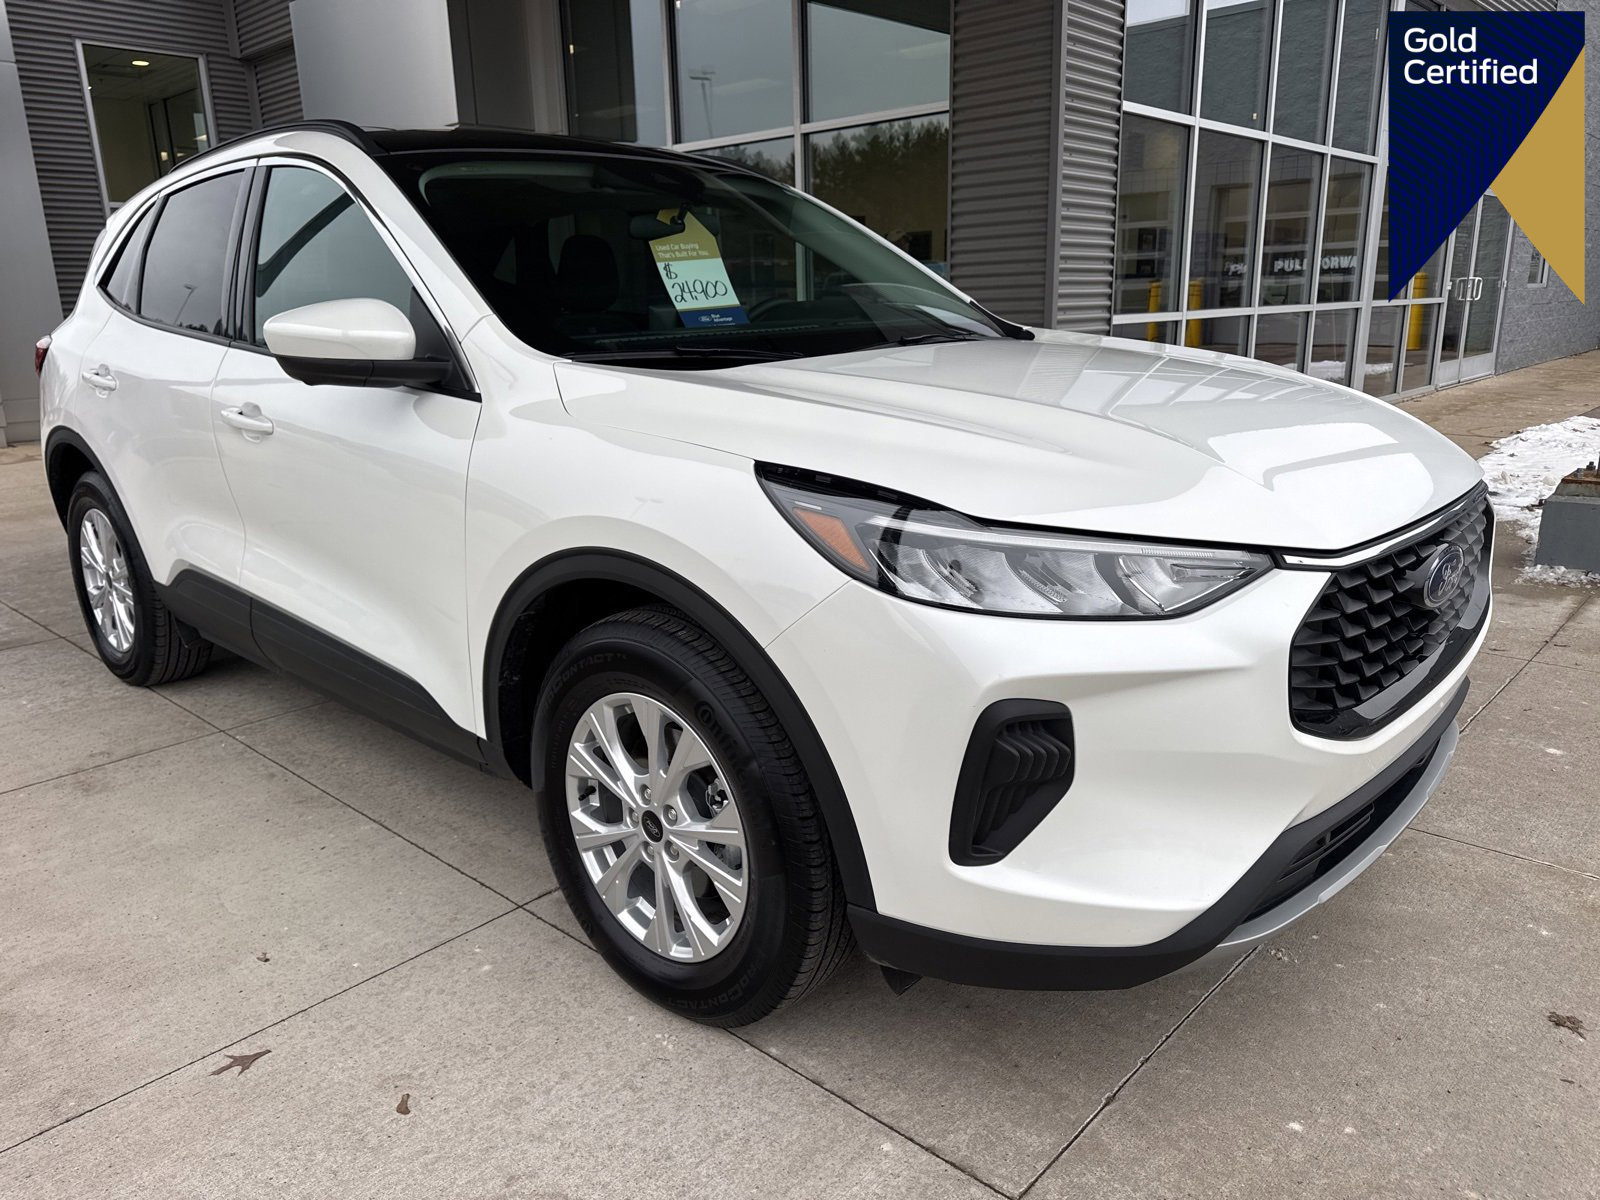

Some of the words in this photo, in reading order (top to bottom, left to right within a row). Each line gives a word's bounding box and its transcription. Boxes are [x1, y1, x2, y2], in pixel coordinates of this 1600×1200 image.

[655, 243, 670, 251] Used
[1319, 255, 1358, 270] ORWA
[663, 262, 678, 280] $
